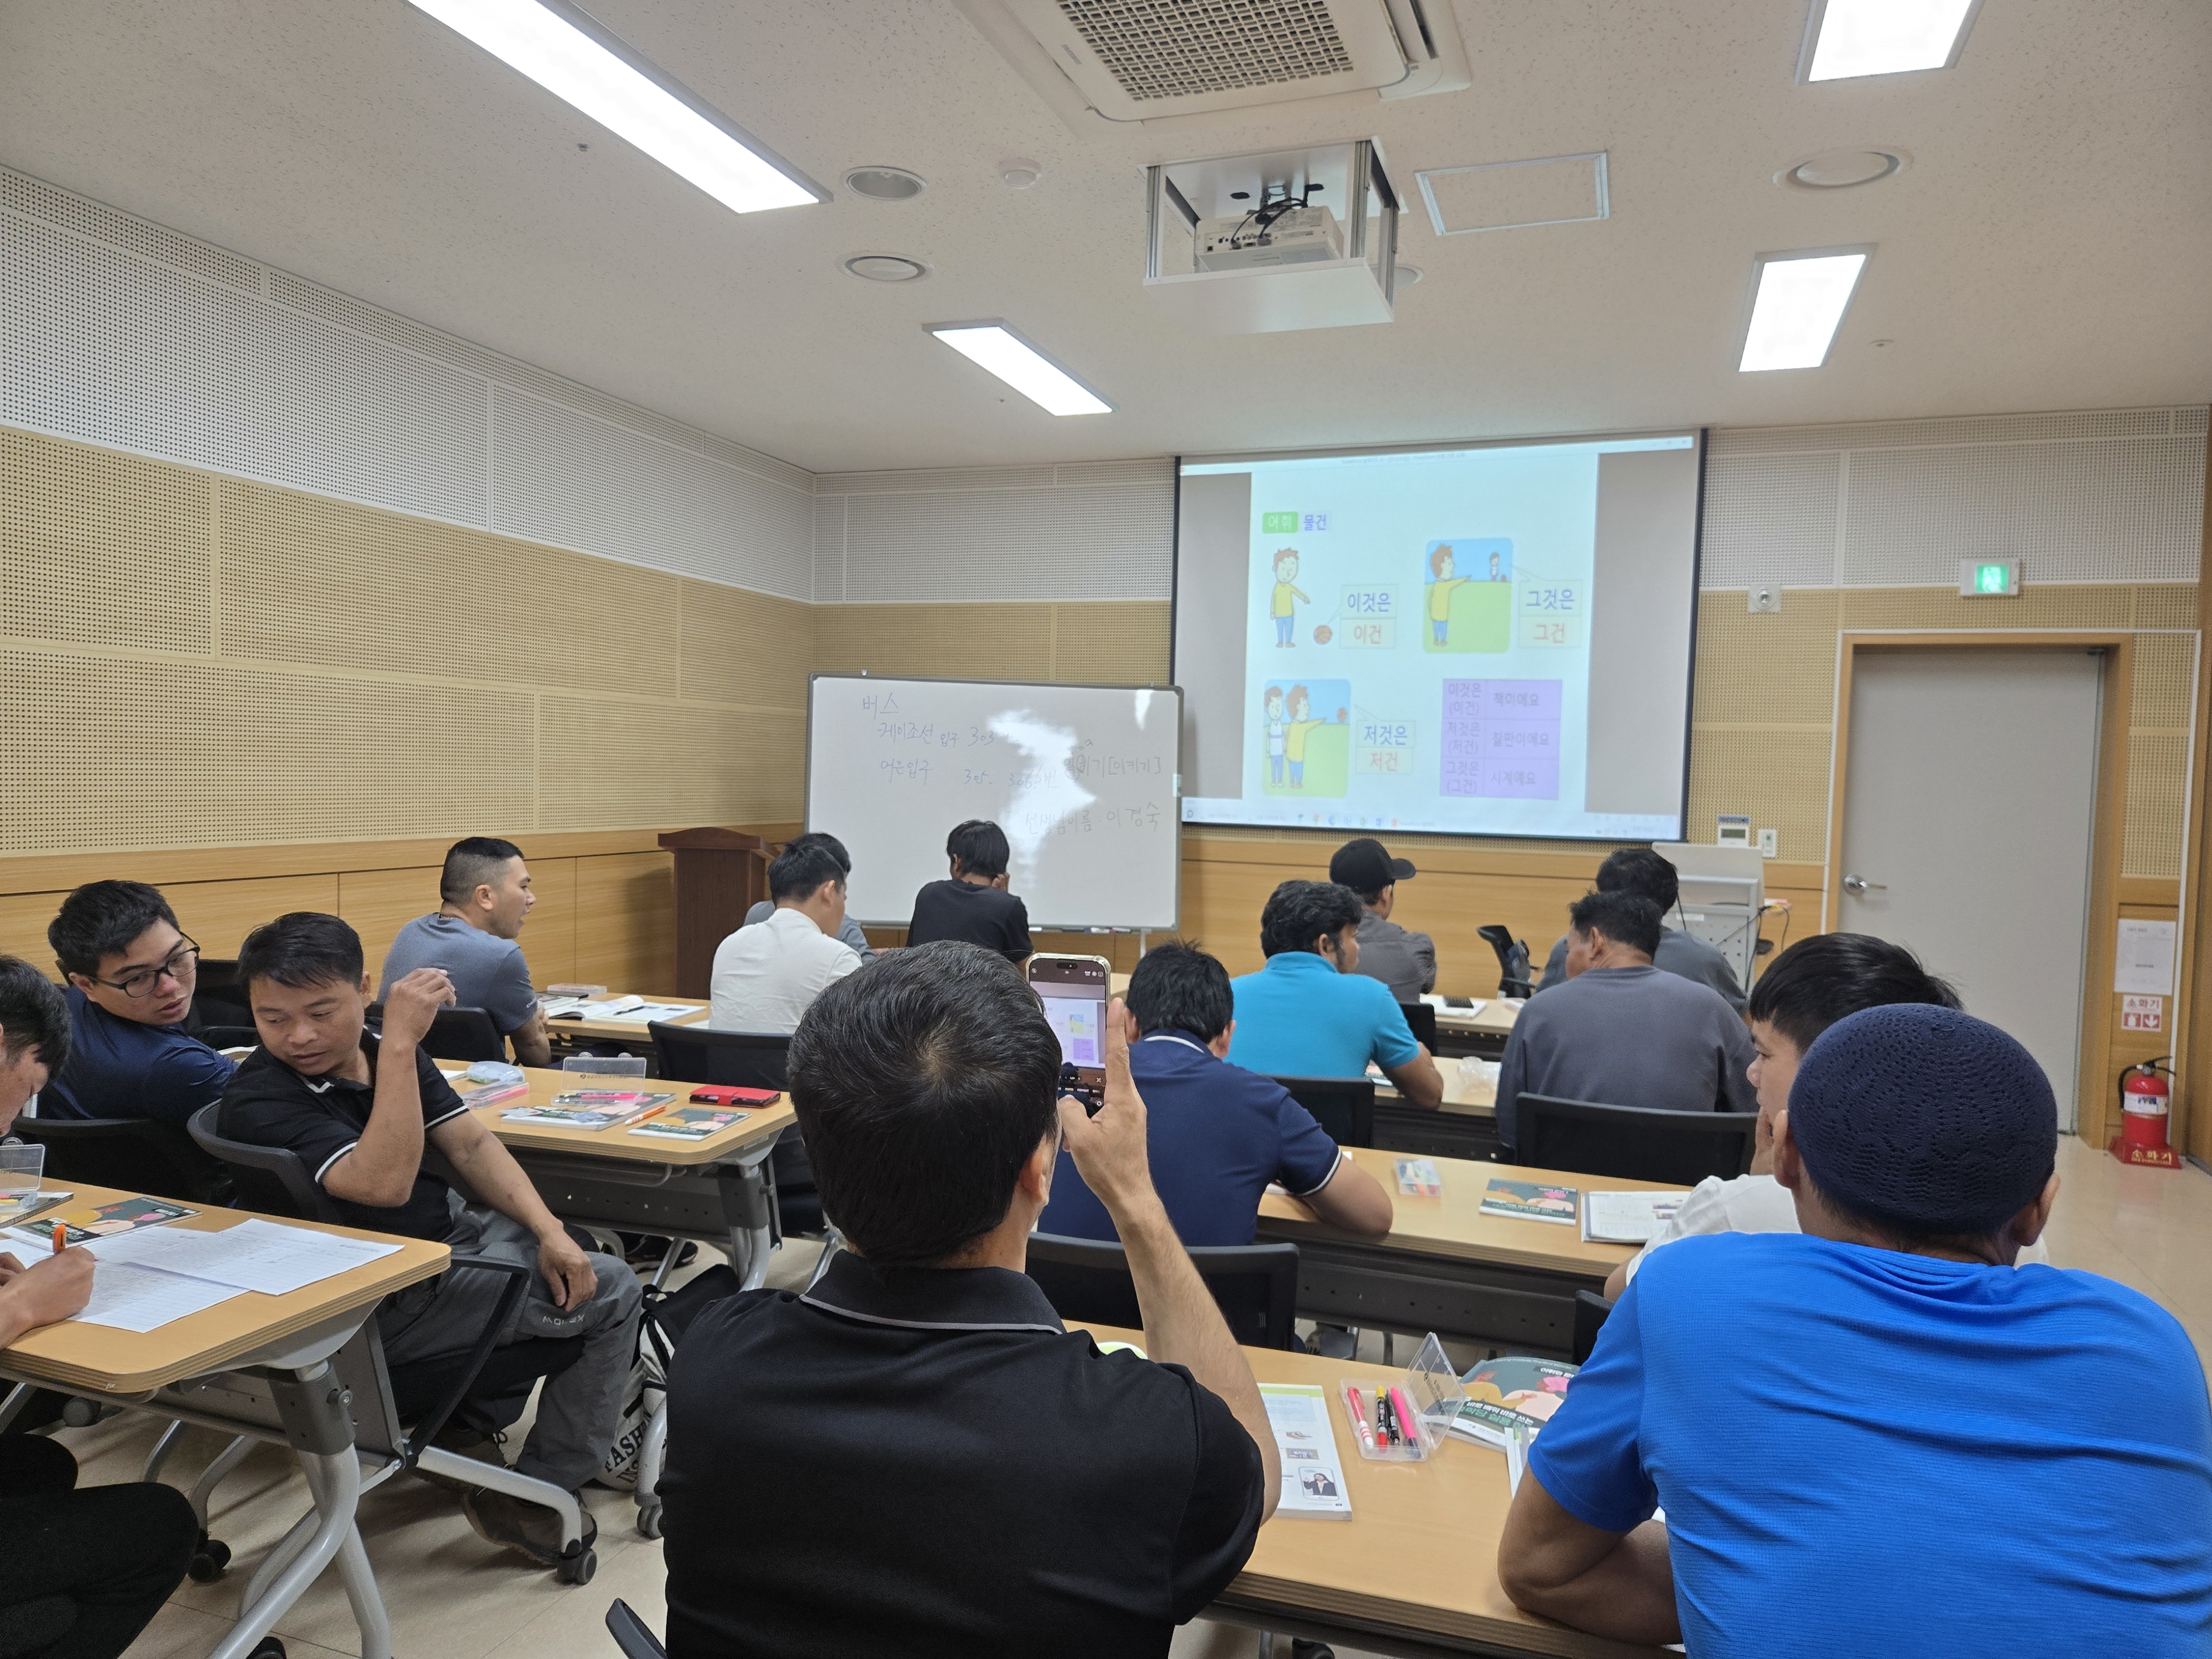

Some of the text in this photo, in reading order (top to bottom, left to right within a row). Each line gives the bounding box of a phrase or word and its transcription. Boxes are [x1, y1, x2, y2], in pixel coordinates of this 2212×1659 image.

[1267, 514, 1326, 531] 어휘 물건
[1347, 592, 1391, 613] 이것은
[1526, 588, 1574, 610] 그것은
[1354, 624, 1381, 644] 이건
[1533, 623, 1564, 644] 그건
[1448, 682, 1482, 698] 이것은
[863, 692, 900, 720] 버스
[1449, 701, 1479, 716] (이건)
[1493, 692, 1540, 708] 책이에요
[1364, 725, 1408, 745] 저것은
[1447, 721, 1481, 737] 저것은
[1448, 739, 1478, 755] (저건)
[1369, 752, 1397, 772] 저건
[1445, 760, 1479, 776] 그것은
[1447, 779, 1477, 795] (그건)
[1467, 1401, 1484, 1410] 바로
[1483, 1405, 1500, 1415] 배워
[1499, 1409, 1517, 1420] 바로
[1516, 1416, 1535, 1427] 쓰는
